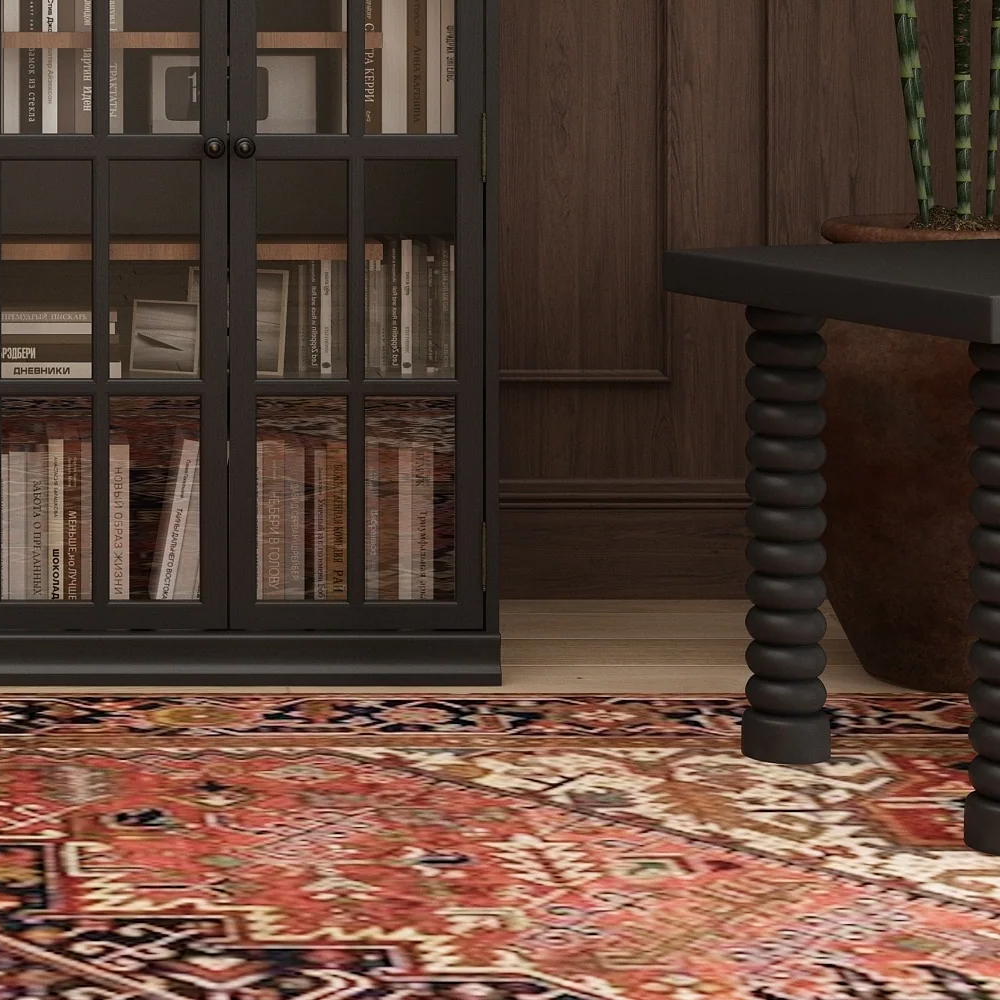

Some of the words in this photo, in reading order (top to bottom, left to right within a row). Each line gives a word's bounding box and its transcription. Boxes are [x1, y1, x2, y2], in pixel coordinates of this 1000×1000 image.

[28, 78, 35, 89] из
[109, 63, 118, 118] ТРАКТАТЫ
[364, 68, 375, 103] КЕРРИ
[28, 92, 36, 122] стекла
[1, 347, 36, 360] РЭДБЕРИ
[13, 366, 71, 376] ДНЕВНИКИ
[32, 480, 42, 518] ЗАБОТА
[113, 467, 125, 510] НОВЫЙ
[268, 491, 280, 505] НЕ
[32, 521, 42, 529] О
[113, 512, 123, 549] ОБРАЗ
[268, 507, 280, 535] БЕРИ
[31, 532, 42, 596] ПРЕДАННЫХ
[51, 548, 60, 600] ШОКОЛАД
[113, 552, 123, 595] ЖИЗНИ
[268, 547, 280, 590] ГОЛОВУ
[67, 567, 78, 600] ЛУЧШЕ
[333, 570, 346, 593] РАЙ
